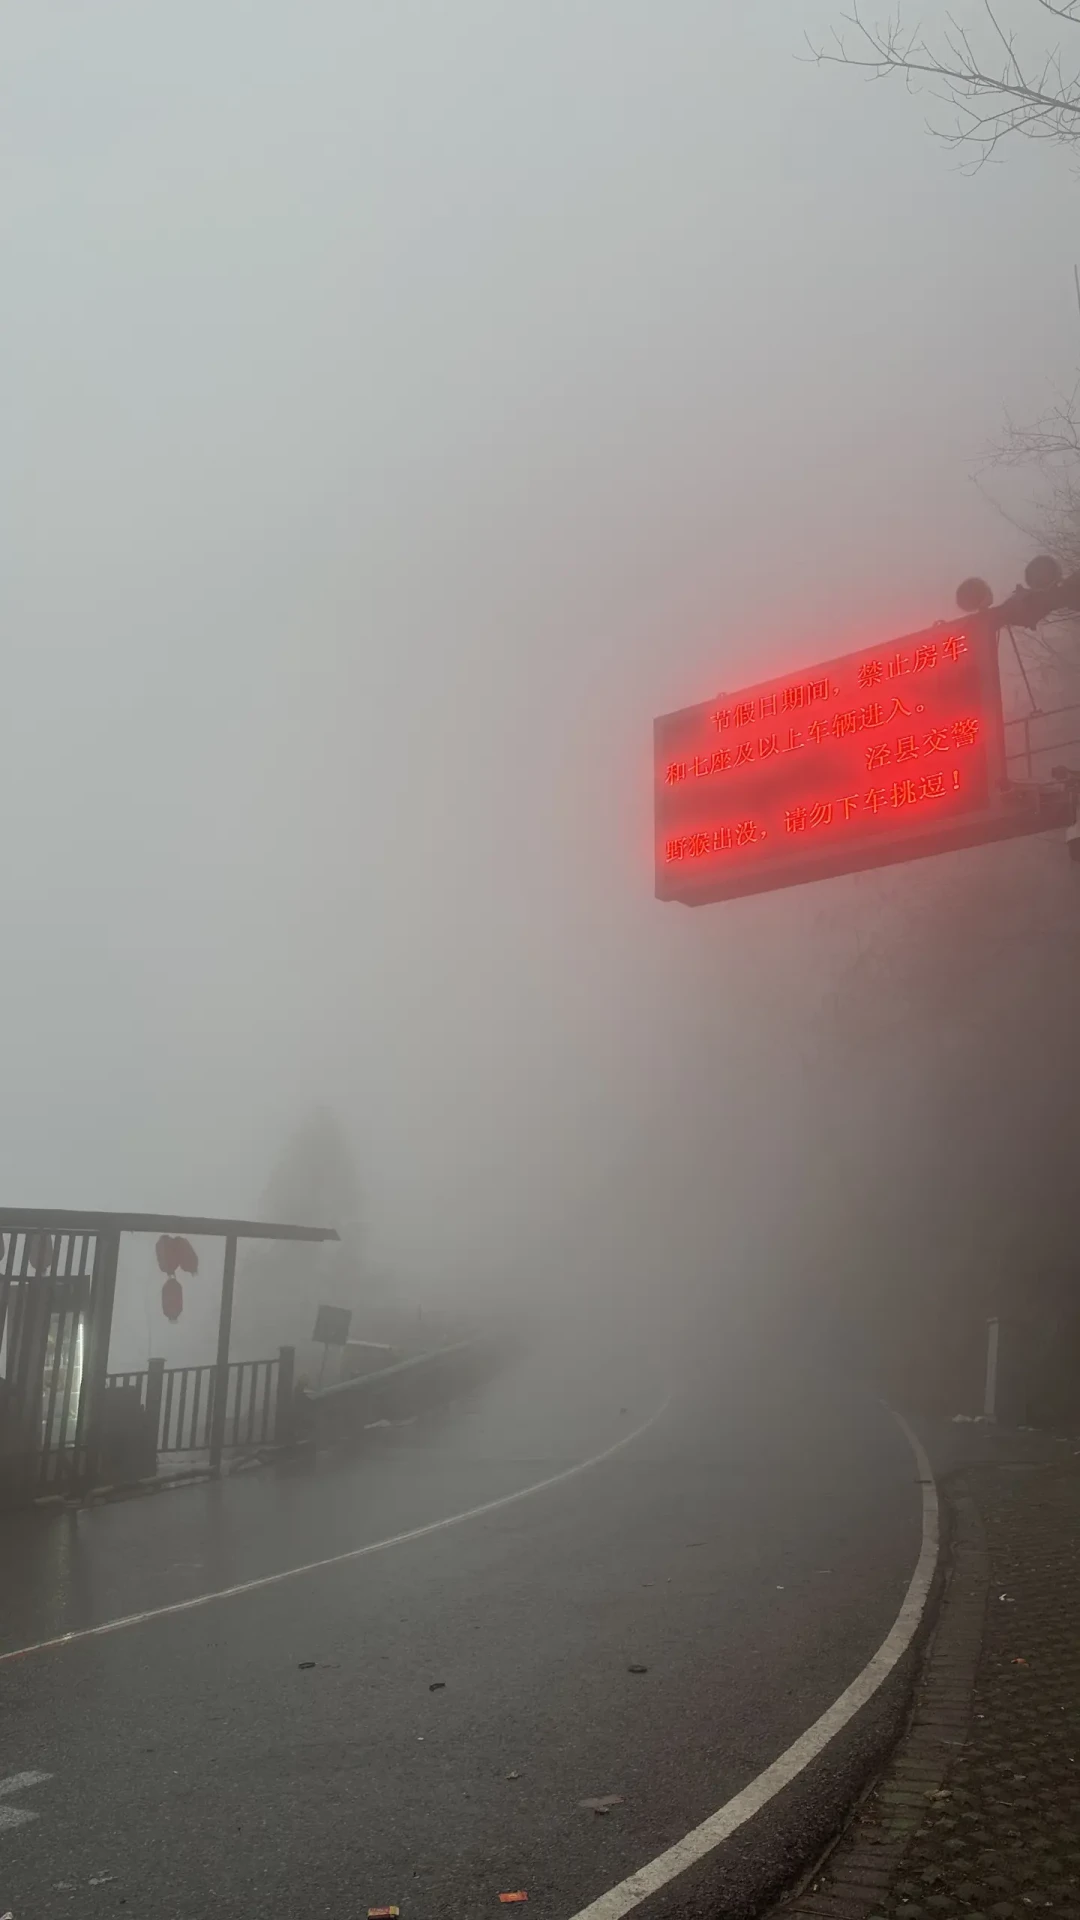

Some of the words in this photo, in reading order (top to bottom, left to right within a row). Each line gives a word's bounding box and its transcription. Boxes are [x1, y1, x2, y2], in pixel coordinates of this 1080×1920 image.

[711, 634, 968, 733] 节假日期间，禁止房车
[665, 697, 927, 785] 和七座及以上车辆进入。
[865, 718, 979, 771] 泾县交警
